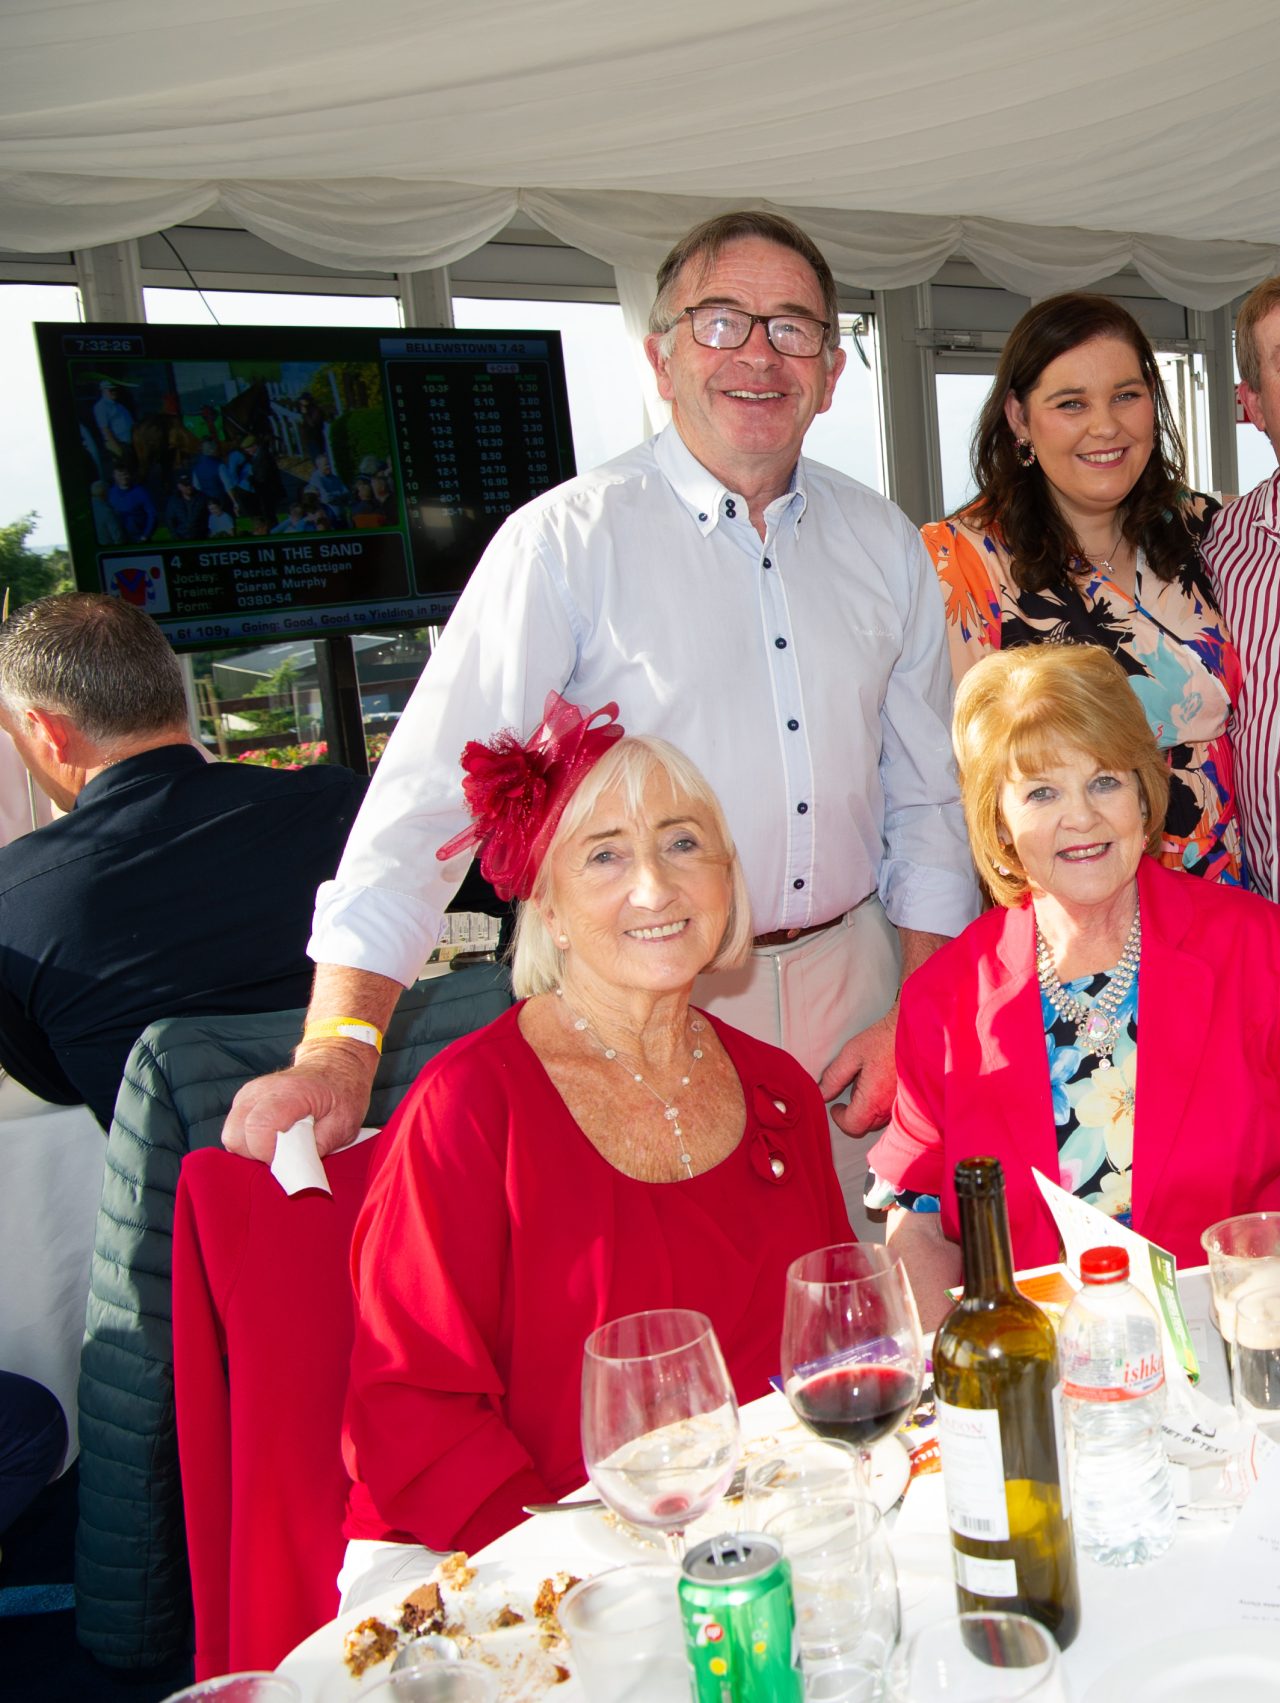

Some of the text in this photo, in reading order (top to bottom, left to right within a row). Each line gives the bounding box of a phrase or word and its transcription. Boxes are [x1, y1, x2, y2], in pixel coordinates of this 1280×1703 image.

[75, 340, 132, 351] 7:32:26
[406, 343, 526, 353] BELLEWSTOWN 7.42
[429, 412, 451, 421] 11-2
[170, 543, 363, 568] 4 STEPS IN THE SAND
[233, 565, 278, 579] Patrick
[284, 561, 353, 575] McGettigan
[235, 581, 277, 593] Ciaran
[282, 576, 327, 590] Murphy
[196, 625, 231, 640] 109y
[242, 620, 281, 634] Going:
[284, 616, 318, 629] Good,
[321, 613, 350, 625] Good
[353, 611, 366, 622] to
[369, 605, 413, 621] Yielding
[417, 604, 427, 616] in
[431, 602, 452, 615] Plac
[1200, 1442, 1230, 1455] TEXT
